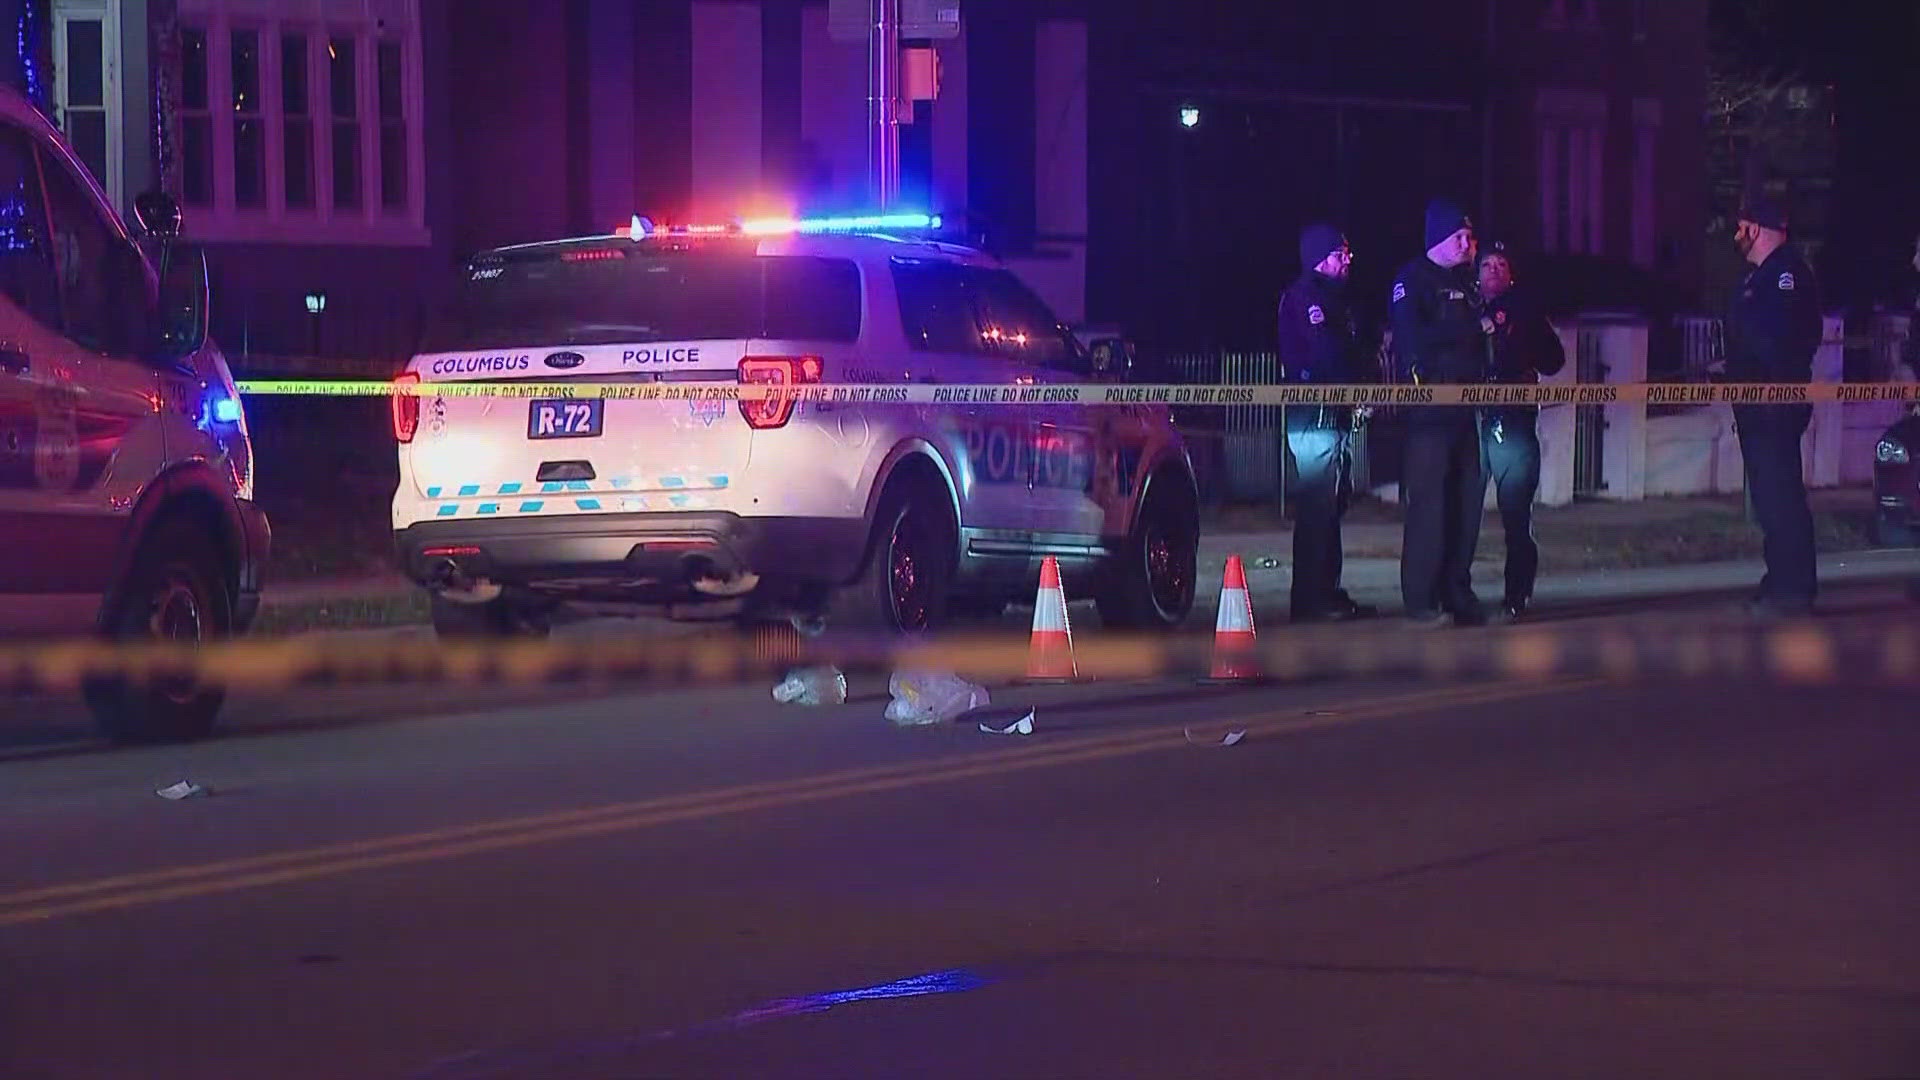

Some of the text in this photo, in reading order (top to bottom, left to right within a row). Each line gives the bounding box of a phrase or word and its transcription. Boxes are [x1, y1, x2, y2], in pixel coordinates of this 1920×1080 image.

[432, 355, 530, 374] COLUMBUS
[622, 348, 700, 365] POLICE
[600, 386, 740, 400] POLICE LINE DO NOT CROSS
[765, 388, 908, 401] POLICE LINE DO NOT CROSS
[933, 388, 1080, 402] POLICE LINE DO NOT CROSS
[1105, 388, 1254, 402] POLICE LINE DO NOT CROSS
[1281, 388, 1433, 402] POLICE LINE DO NOT CROSS
[1461, 387, 1617, 402] POLICE LINE DO NOT CROSS
[1647, 386, 1807, 402] POLICE LINE DO NOT CROSS
[1837, 386, 1879, 400] POLICE
[1881, 386, 1908, 400] LINE
[538, 404, 592, 435] R-72
[967, 424, 1085, 483] POLICE
